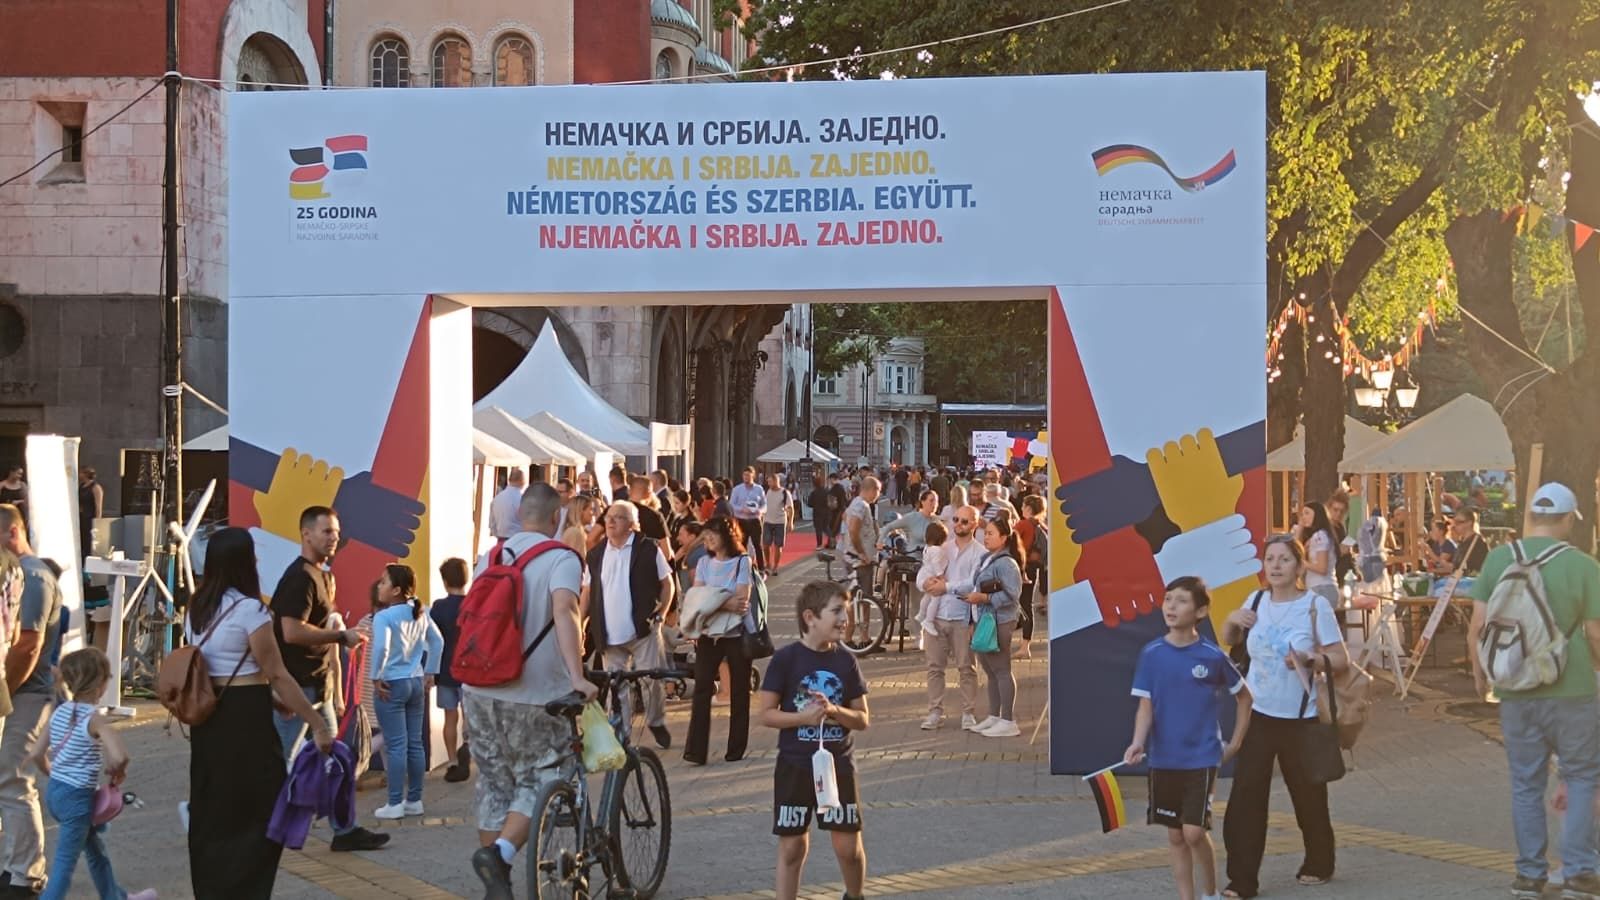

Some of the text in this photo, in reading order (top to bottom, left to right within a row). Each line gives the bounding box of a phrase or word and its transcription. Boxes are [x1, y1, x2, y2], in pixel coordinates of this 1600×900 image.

[545, 115, 946, 146] НЕМАЧКА И СРБИЈА. ЗАЈЕДНО.
[546, 150, 936, 181] NEMAČKA I SRBIJA. ZAJEDNO.
[507, 179, 977, 215] NÉMETORSZÁG ÉS SZERBIA. EGYÜTT.
[1099, 189, 1173, 201] немачка
[296, 206, 377, 219] 25 GODINA
[1098, 205, 1153, 217] сарадња
[539, 219, 943, 249] NJEMAČKA I SRBIJA. ZAJEDNO.
[777, 805, 808, 828] JUST
